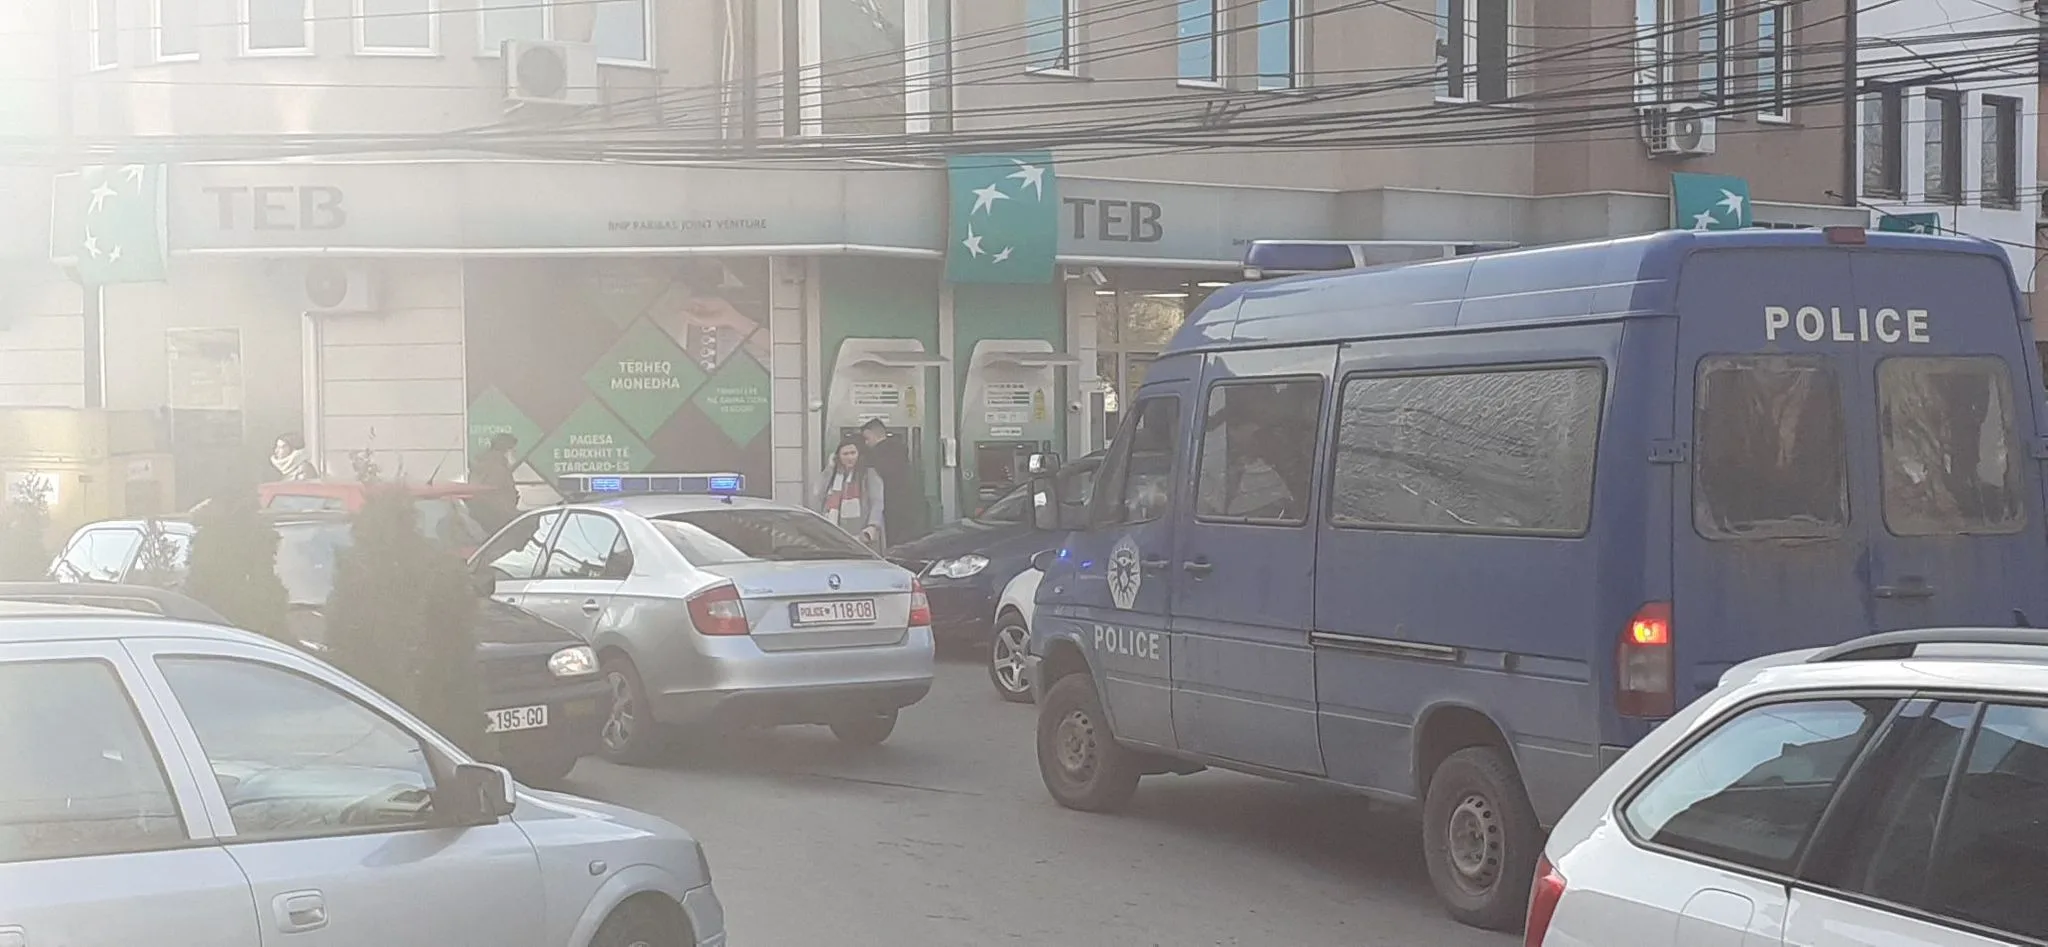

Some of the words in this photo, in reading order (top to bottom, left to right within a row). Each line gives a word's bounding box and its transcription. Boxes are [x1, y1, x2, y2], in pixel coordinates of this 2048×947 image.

[203, 186, 346, 231] TEB
[681, 219, 711, 231] JOINT
[717, 218, 767, 229] VENTURE
[1063, 197, 1164, 242] TEB
[1764, 306, 1931, 343] POLICE
[611, 376, 681, 390] MONEDHA
[570, 434, 613, 445] PAGESA
[554, 448, 560, 459] E
[800, 607, 825, 617] POLICE
[1094, 625, 1160, 660] POLICE
